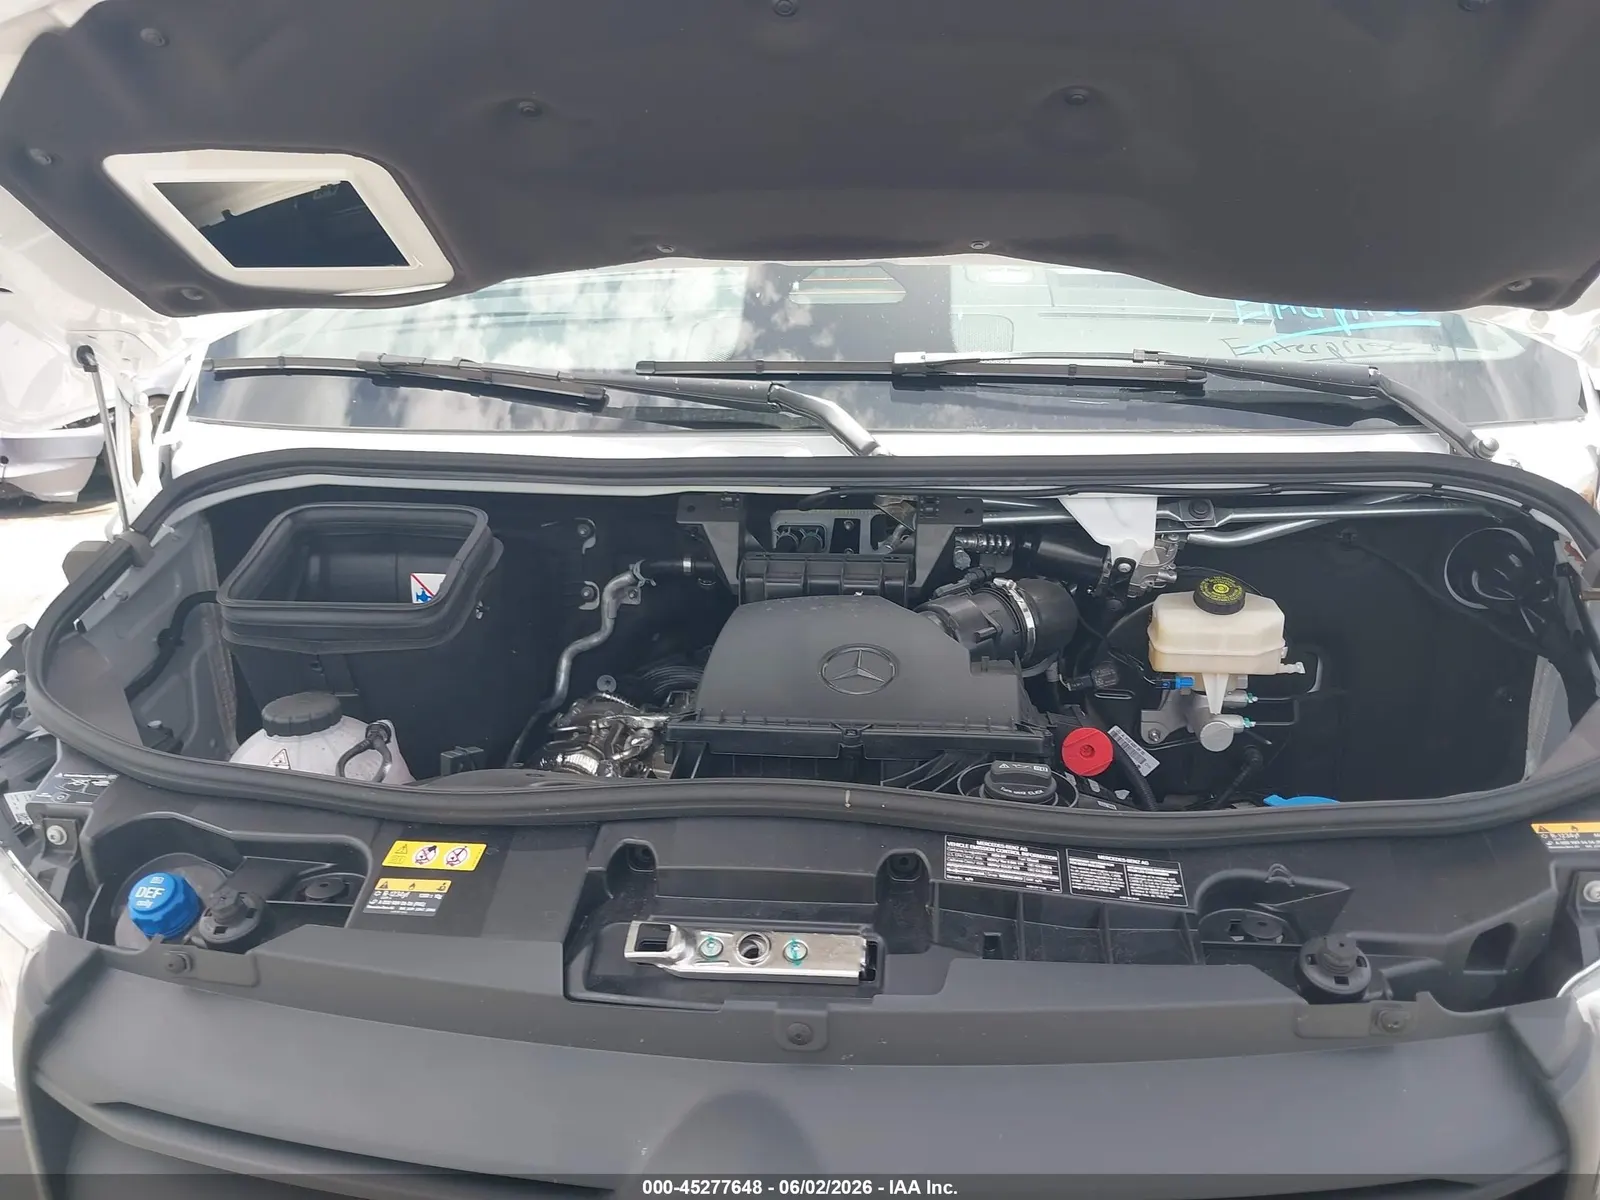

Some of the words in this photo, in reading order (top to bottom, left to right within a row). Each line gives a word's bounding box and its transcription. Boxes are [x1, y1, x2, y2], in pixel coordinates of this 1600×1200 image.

[946, 841, 970, 849] VEHICLE
[976, 840, 1020, 851] MERCEDES-BENZ
[135, 886, 165, 898] DEF
